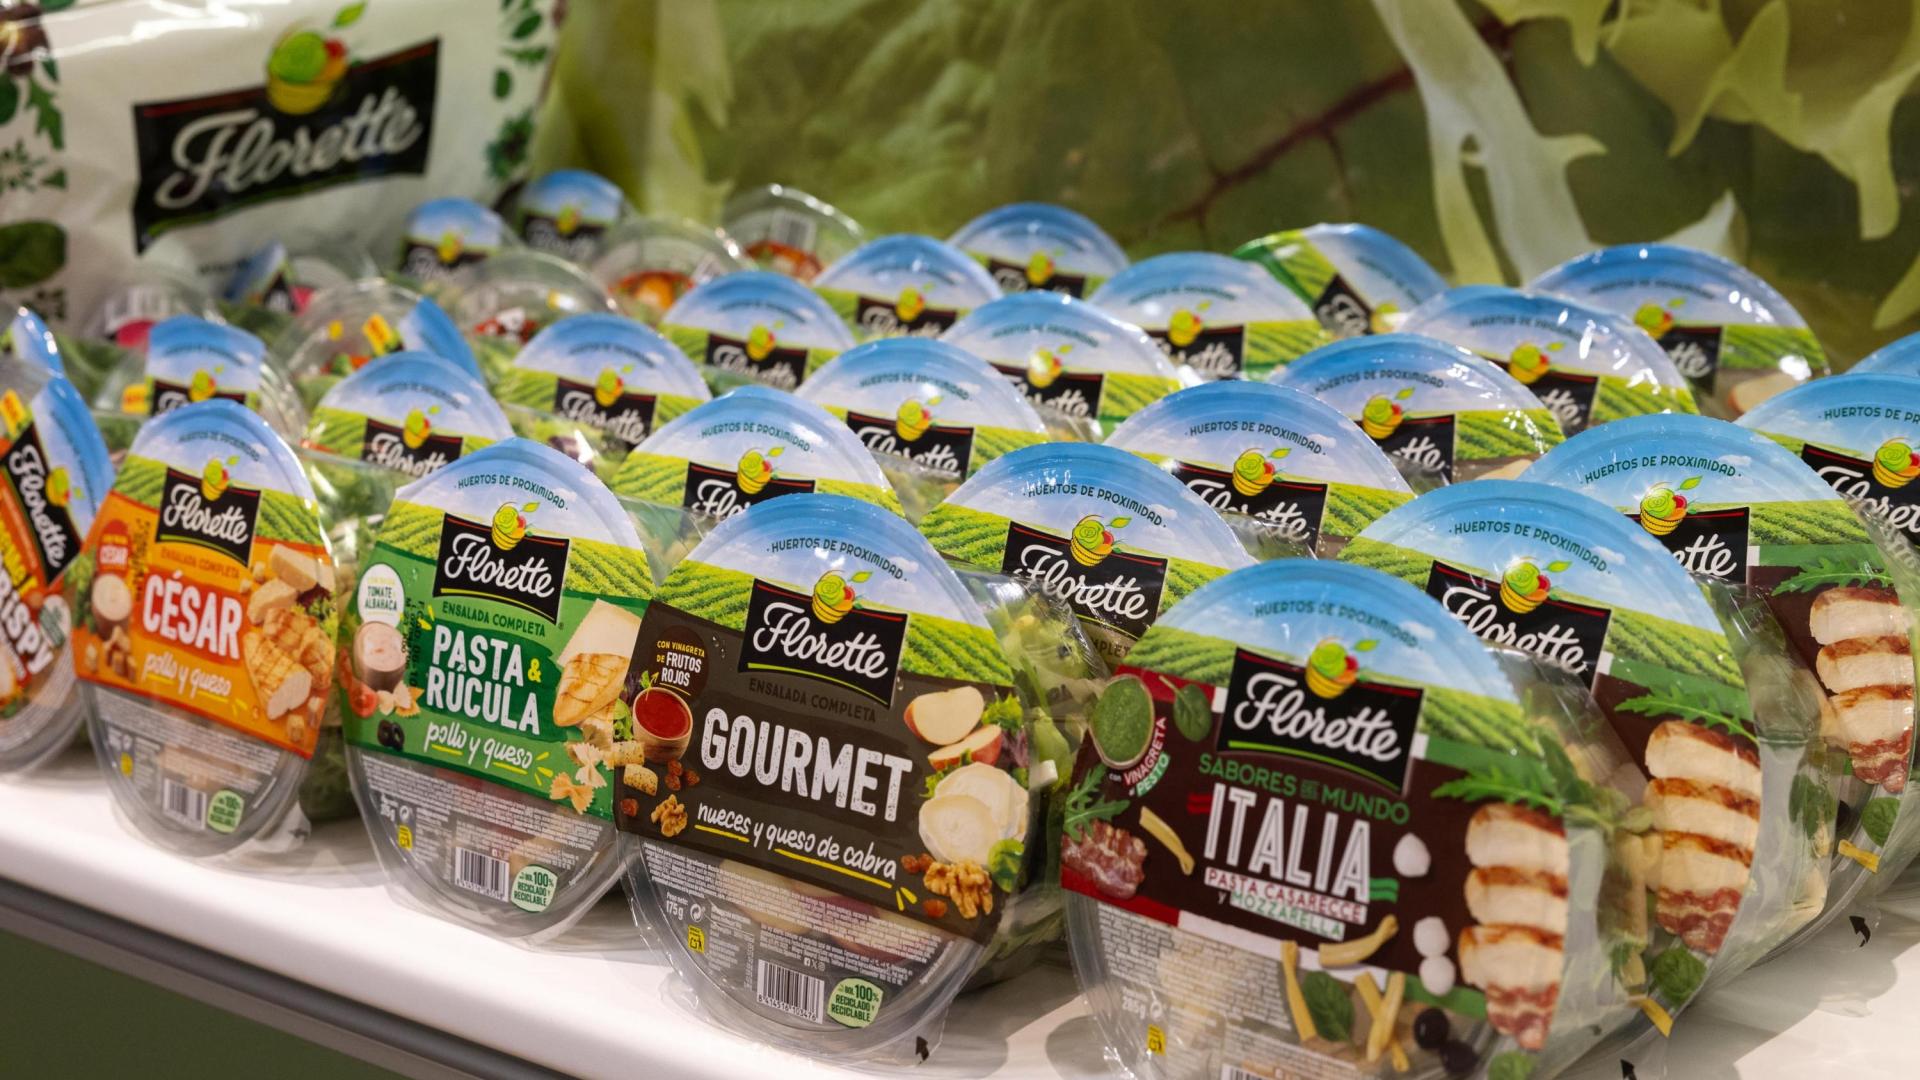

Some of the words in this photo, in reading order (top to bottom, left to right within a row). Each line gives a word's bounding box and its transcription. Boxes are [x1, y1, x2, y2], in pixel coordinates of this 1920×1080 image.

[156, 87, 424, 209] Florette
[701, 422, 741, 440] HUERTOS
[743, 423, 754, 432] DE
[756, 424, 811, 453] PROXIMIDAD
[1824, 406, 1880, 421] HUERTOS
[1884, 407, 1901, 421] DE
[1190, 421, 1239, 437] HUERTOS
[1241, 422, 1255, 433] DE
[1258, 423, 1323, 455] PROXIMIDAD
[458, 473, 498, 489] HUERTOS
[499, 475, 510, 485] DE
[512, 476, 566, 511] PROXIMIDAD
[1584, 459, 1639, 484] HUERTOS
[1642, 455, 1657, 468] DE
[1660, 455, 1737, 478] PROXIMIDAD
[9, 443, 66, 569] Florette
[163, 482, 250, 545] Florette
[1027, 483, 1077, 498] HUERTOS
[1080, 485, 1095, 498] DE
[1098, 488, 1163, 528] PROXIMIDAD
[443, 532, 555, 599] Florette
[770, 536, 821, 554] HUERTOS
[823, 538, 838, 550] DE
[839, 542, 906, 581] PROXIMIDAD
[1454, 522, 1511, 536] HUERTOS
[1514, 524, 1530, 537] DE
[1533, 528, 1608, 574] PROXIMIDAD
[1014, 543, 1149, 621] Florette
[142, 569, 244, 660] CÉSAR
[442, 600, 491, 624] ENSALADA
[491, 609, 546, 638] COMPLETA
[1254, 601, 1316, 618] HUERTOS
[1317, 602, 1335, 615] DE
[1337, 604, 1421, 650] PROXIMIDAD
[433, 623, 525, 688] PASTA
[527, 657, 542, 683] &
[656, 639, 670, 650] CON
[671, 641, 706, 659] VINAGRETA
[656, 654, 666, 664] DE
[666, 651, 703, 674] FRUTOS
[752, 601, 889, 680] Florette
[143, 652, 177, 681] pollo
[177, 664, 191, 696] y
[189, 666, 233, 700] queso
[425, 661, 541, 736] RÚCULA
[660, 669, 691, 688] ROJOS
[748, 676, 805, 704] ENSALADA
[809, 694, 877, 725] COMPLETA
[1232, 671, 1403, 763] Florette
[423, 720, 469, 753] pollo
[469, 738, 481, 766] y
[482, 737, 534, 770] queso
[700, 706, 914, 824] GOURMET
[1123, 716, 1168, 788] VINAGRETA
[1135, 751, 1171, 798] PESTO
[1199, 753, 1298, 799] SABORES
[1320, 783, 1411, 825] MUNDO
[696, 801, 750, 836] nueces
[752, 822, 763, 848] y
[765, 823, 816, 854] queso
[816, 833, 840, 860] de
[841, 841, 898, 881] cabra
[1203, 782, 1371, 905] ITALIA
[513, 890, 547, 907] RECICLABLE
[516, 881, 547, 897] RECICLADO
[533, 870, 555, 889] 100%
[1208, 868, 1260, 897] PASTA
[1263, 883, 1364, 924] CASARECCE
[1231, 891, 1343, 939] MOZZARELLA
[830, 1003, 871, 1023] RECICLABLE
[835, 996, 871, 1012] RECICLADO
[854, 984, 880, 1004] 100%
